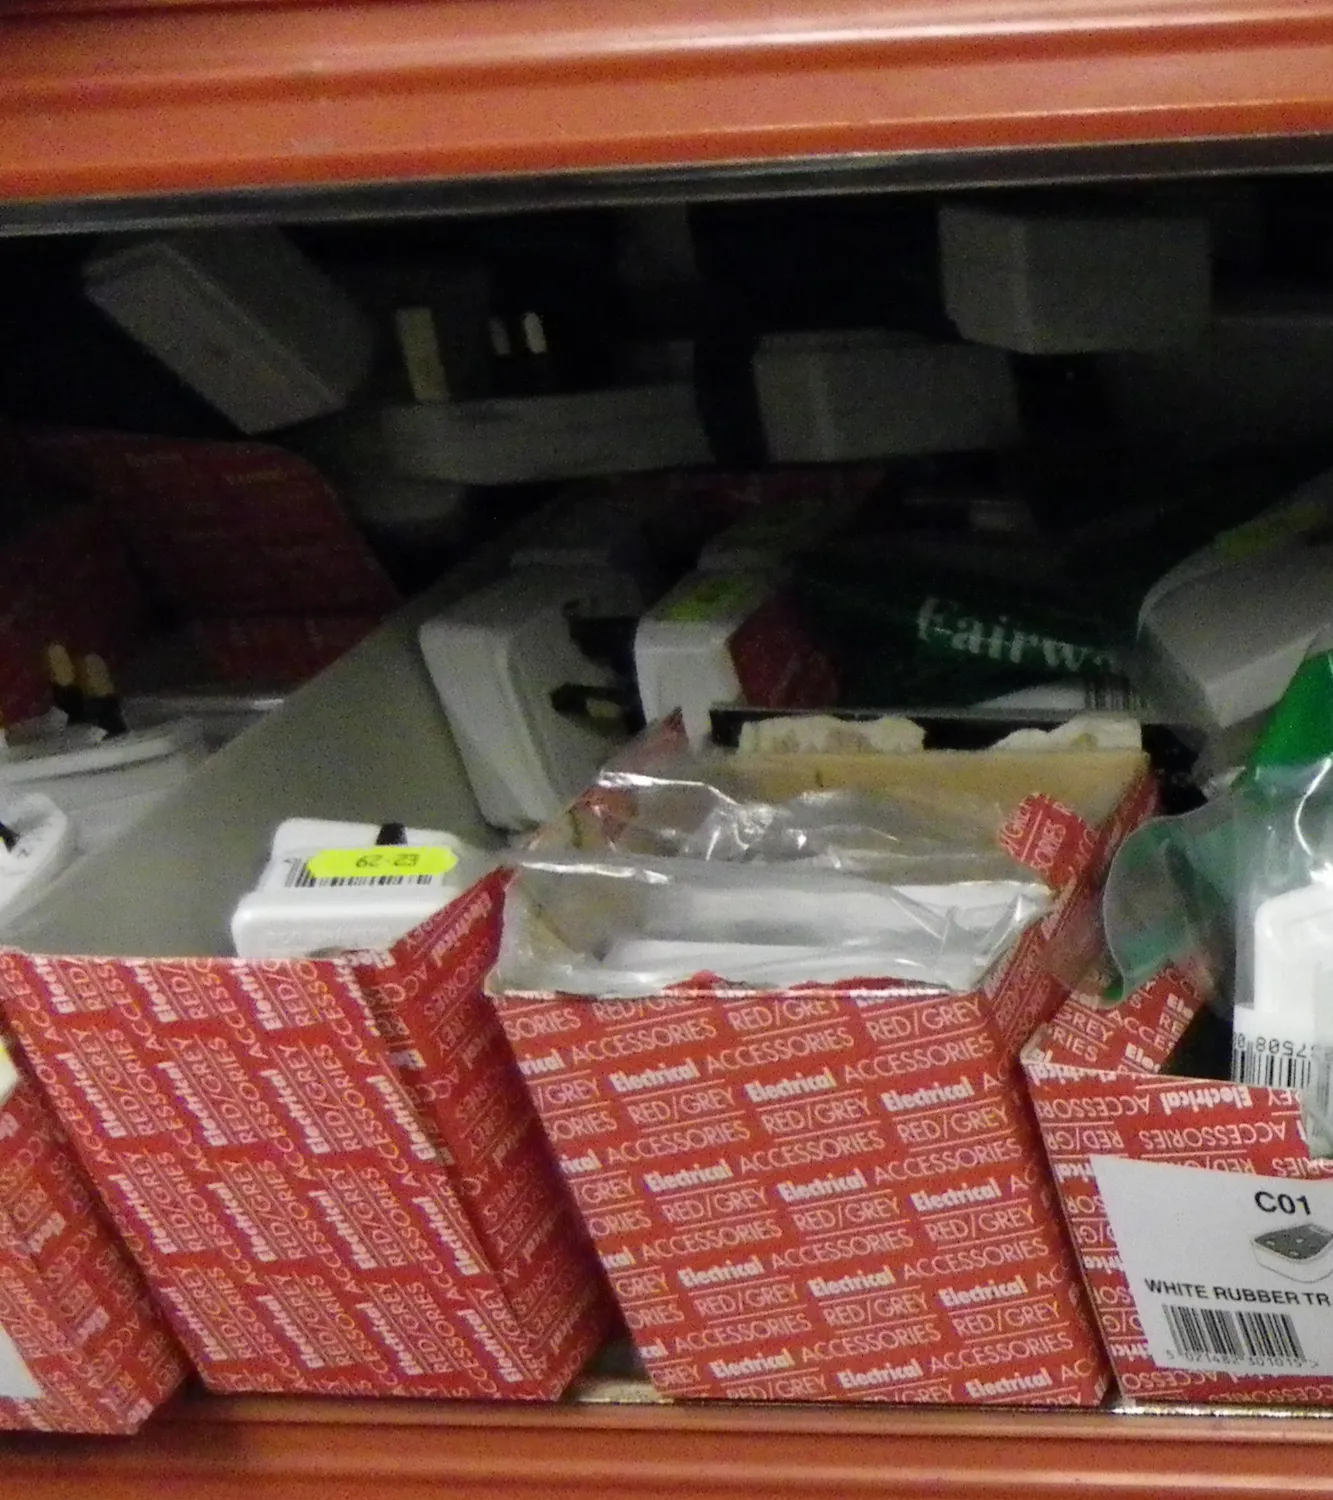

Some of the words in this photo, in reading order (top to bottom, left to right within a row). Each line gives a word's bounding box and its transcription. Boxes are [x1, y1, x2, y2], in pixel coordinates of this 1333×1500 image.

[865, 998, 983, 1042] RED/GREY
[843, 1032, 996, 1084] ACCESSORIES
[744, 1066, 838, 1104] Electrical
[759, 1096, 872, 1136] RED/GREY
[607, 1120, 751, 1166] ACCESSORIES
[643, 1158, 734, 1194] Electrical
[910, 1175, 1003, 1213] Electrical
[924, 1204, 1037, 1243] RED/GREY
[771, 1228, 915, 1270] ACCESSORIES
[693, 1281, 800, 1317] RED/GREY
[806, 1264, 897, 1298] Electrical
[1144, 1277, 1207, 1300] WHITE
[1213, 1286, 1301, 1307] RUBBER
[672, 1312, 814, 1354] ACCESSORIES
[930, 1331, 1075, 1373] ACCESSORIES
[965, 1367, 1054, 1399] Electrical
